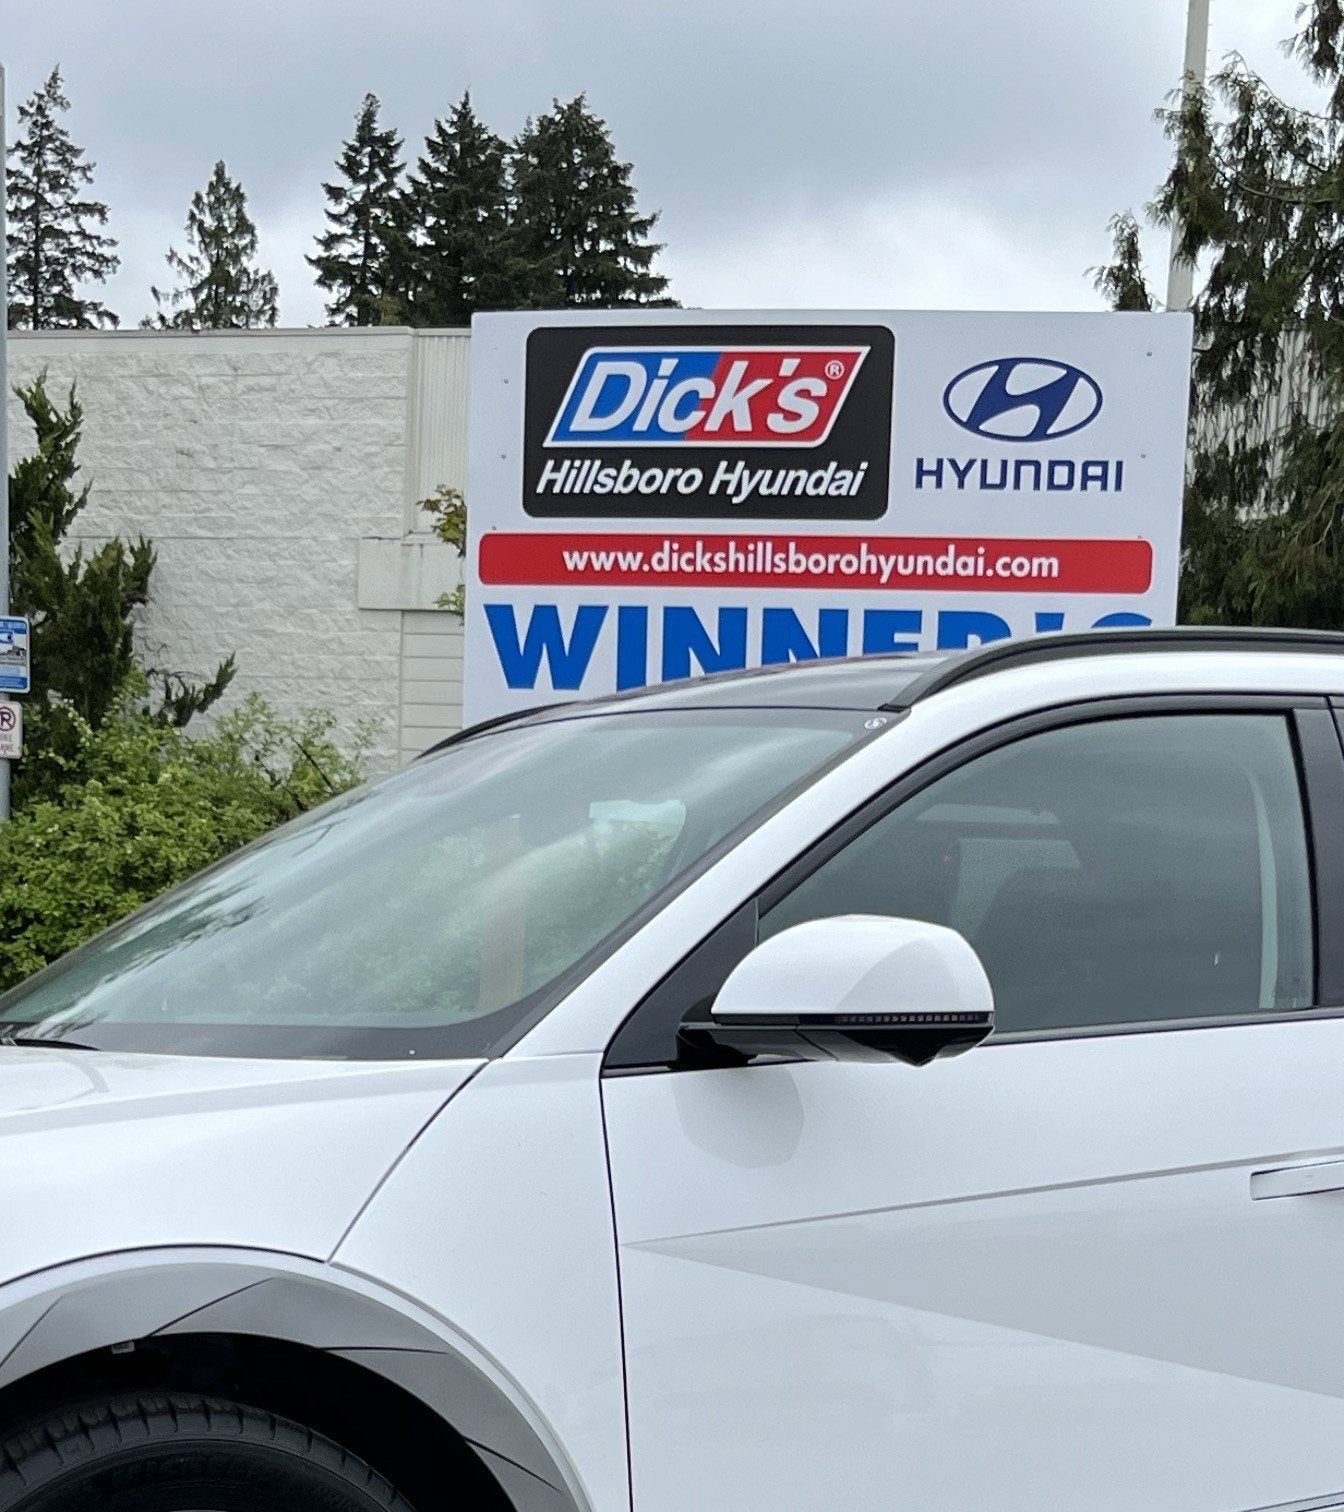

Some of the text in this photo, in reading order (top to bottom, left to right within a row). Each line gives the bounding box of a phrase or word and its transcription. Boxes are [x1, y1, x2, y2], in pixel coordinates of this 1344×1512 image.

[536, 458, 869, 504] Hillsboro Hyundai
[915, 457, 1125, 493] HYUNDAI
[562, 540, 1060, 583] www.dickshillsborohyundai.com
